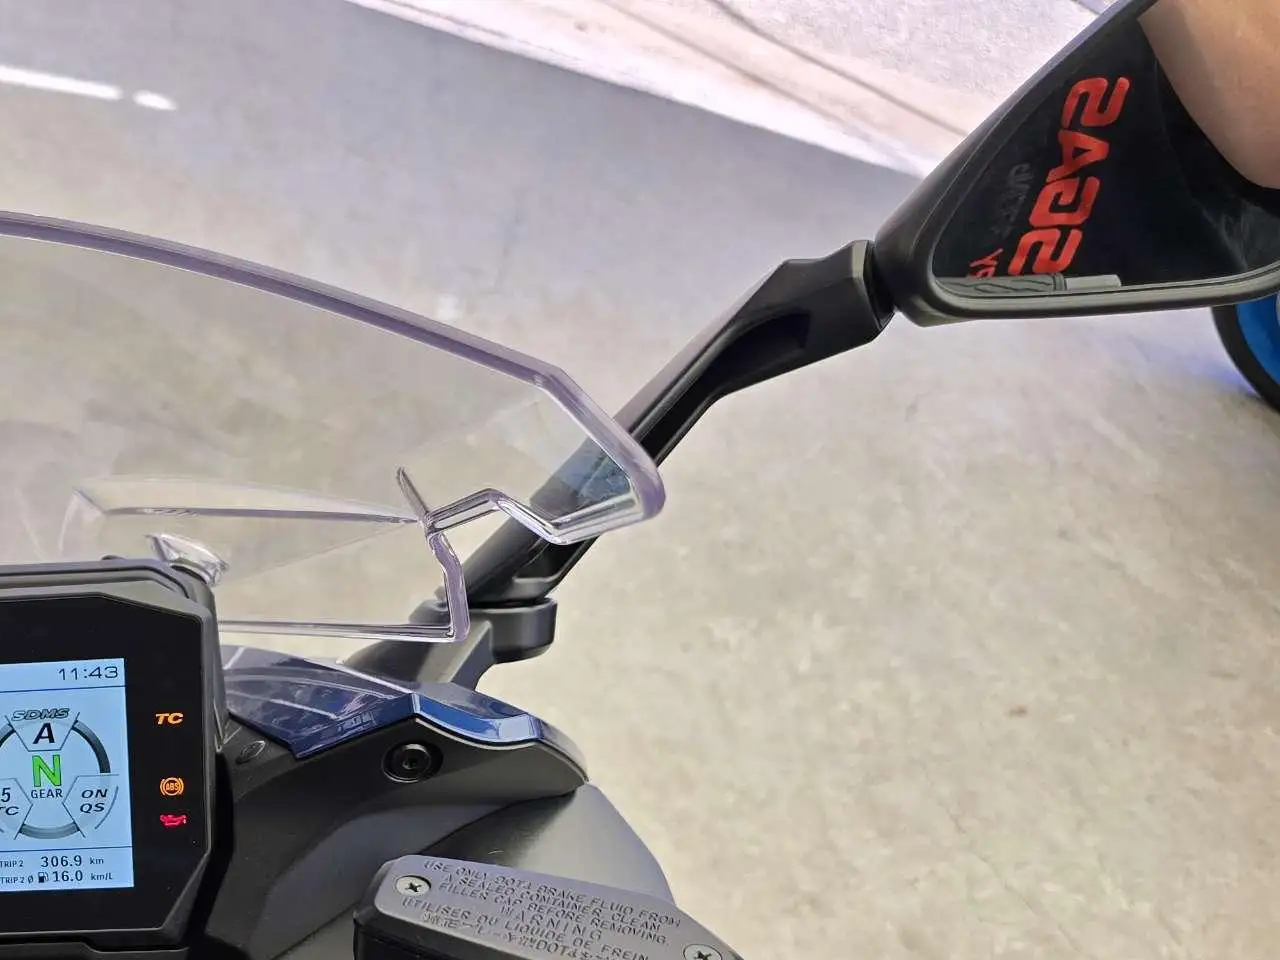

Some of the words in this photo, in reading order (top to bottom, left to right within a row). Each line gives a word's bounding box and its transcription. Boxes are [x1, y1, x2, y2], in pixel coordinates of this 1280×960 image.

[58, 666, 119, 681] 11:43
[11, 707, 71, 721] SDMS
[155, 712, 184, 725] TC
[32, 722, 55, 744] A
[31, 754, 62, 787] N
[1, 787, 11, 802] 5
[31, 788, 63, 799] GEAR
[81, 788, 108, 798] ON
[80, 802, 105, 814] QS
[0, 860, 17, 868] TRIP
[40, 854, 83, 868] 306.9
[89, 857, 104, 865] km
[1, 876, 19, 885] TRIP
[52, 870, 83, 882] 16.0
[423, 860, 451, 873] USE
[456, 865, 488, 880] ONLY
[590, 897, 634, 915] FLUID
[639, 910, 681, 928] FROM
[527, 902, 585, 923] BEFORE
[500, 905, 603, 941] WARNING
[611, 911, 662, 932] CLEAN
[504, 919, 567, 943] LIQUIDE
[572, 937, 594, 951] DE
